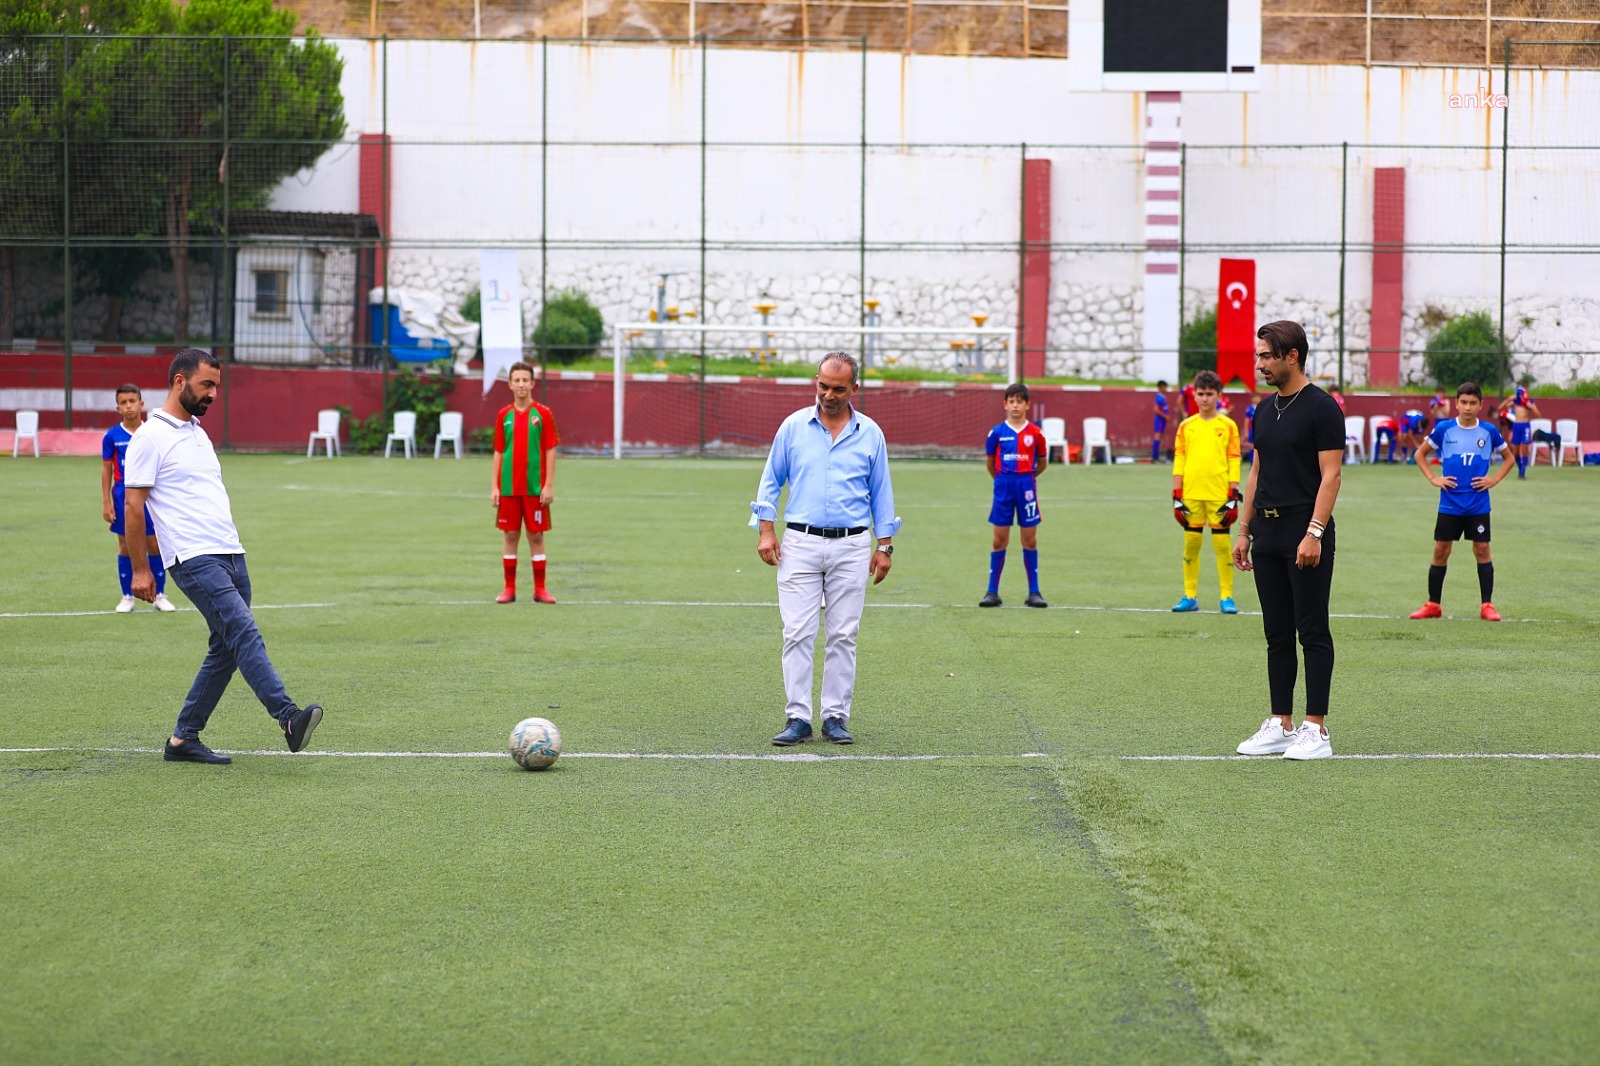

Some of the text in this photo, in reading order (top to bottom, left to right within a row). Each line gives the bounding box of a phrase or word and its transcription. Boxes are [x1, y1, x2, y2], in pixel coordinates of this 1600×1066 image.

[1460, 452, 1475, 466] 17
[1025, 501, 1037, 517] 17
[534, 510, 542, 524] 4
